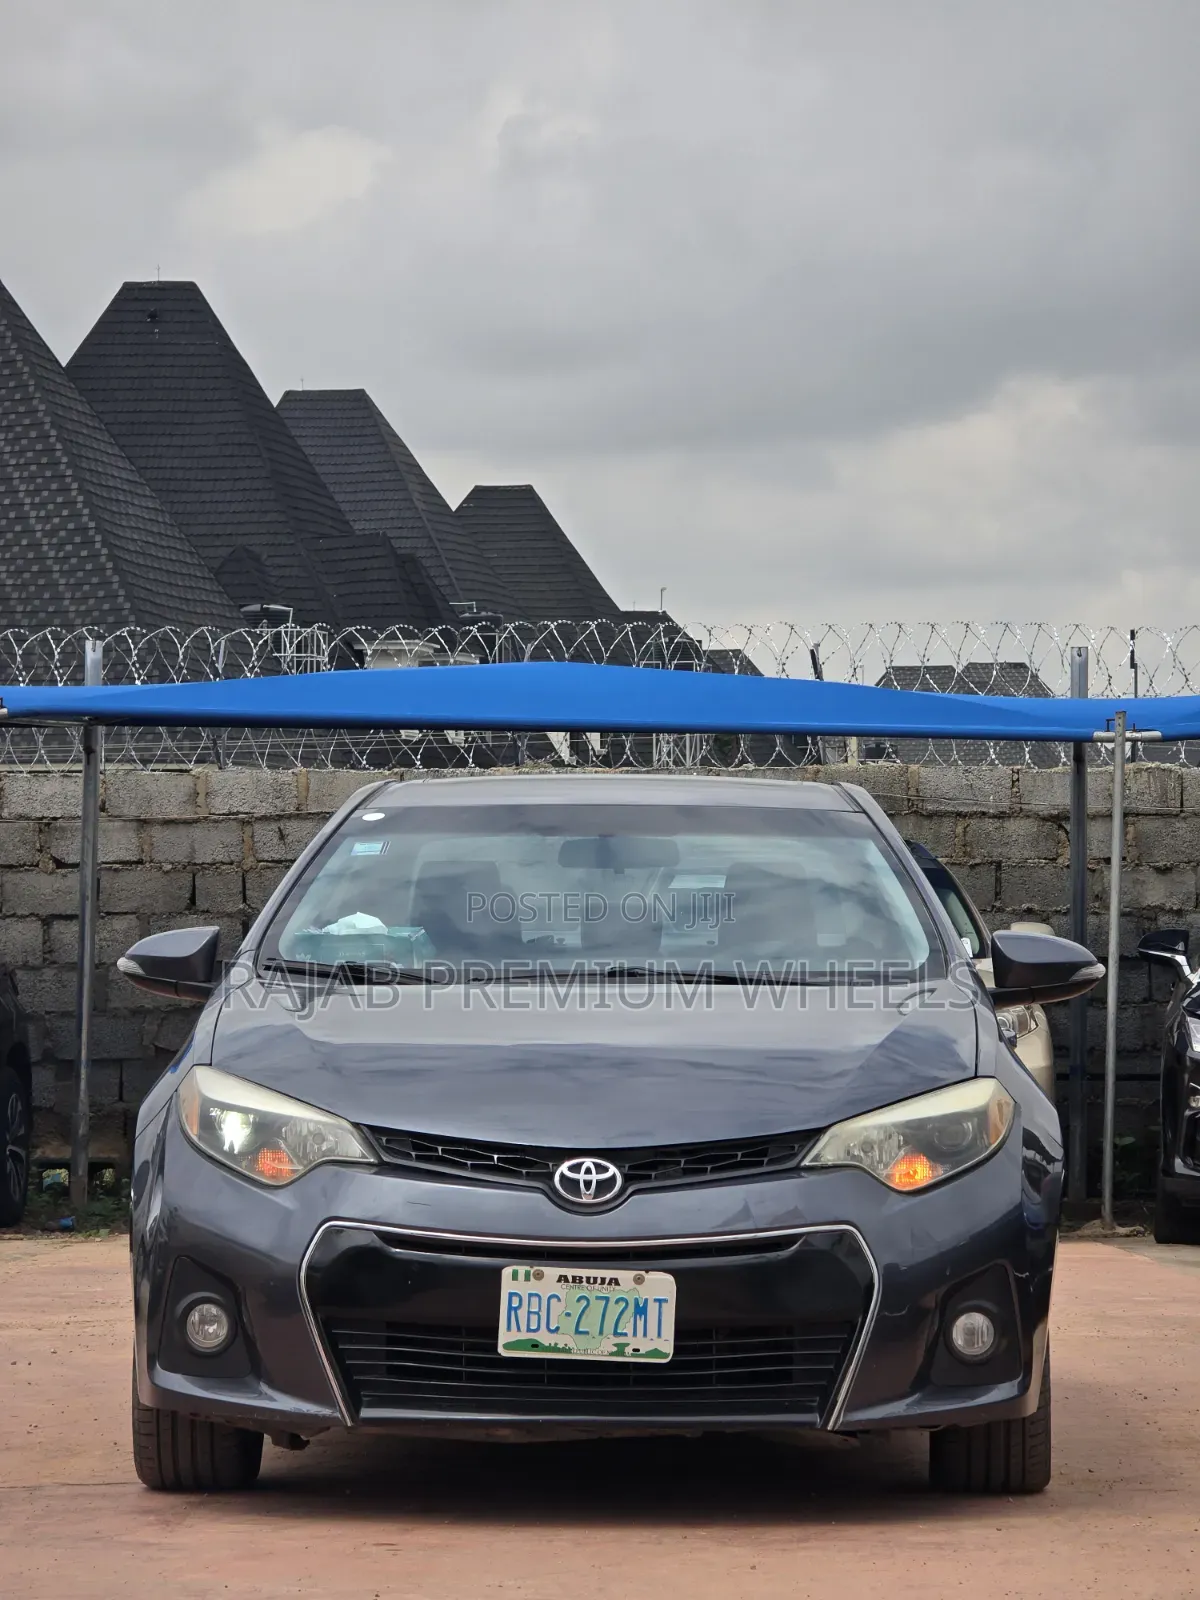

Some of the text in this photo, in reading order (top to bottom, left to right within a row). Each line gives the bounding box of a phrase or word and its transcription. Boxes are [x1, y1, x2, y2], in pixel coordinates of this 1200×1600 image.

[556, 1274, 621, 1286] ABUJA
[560, 1283, 585, 1291] CENTRE
[506, 1291, 669, 1339] RBC-272MT
